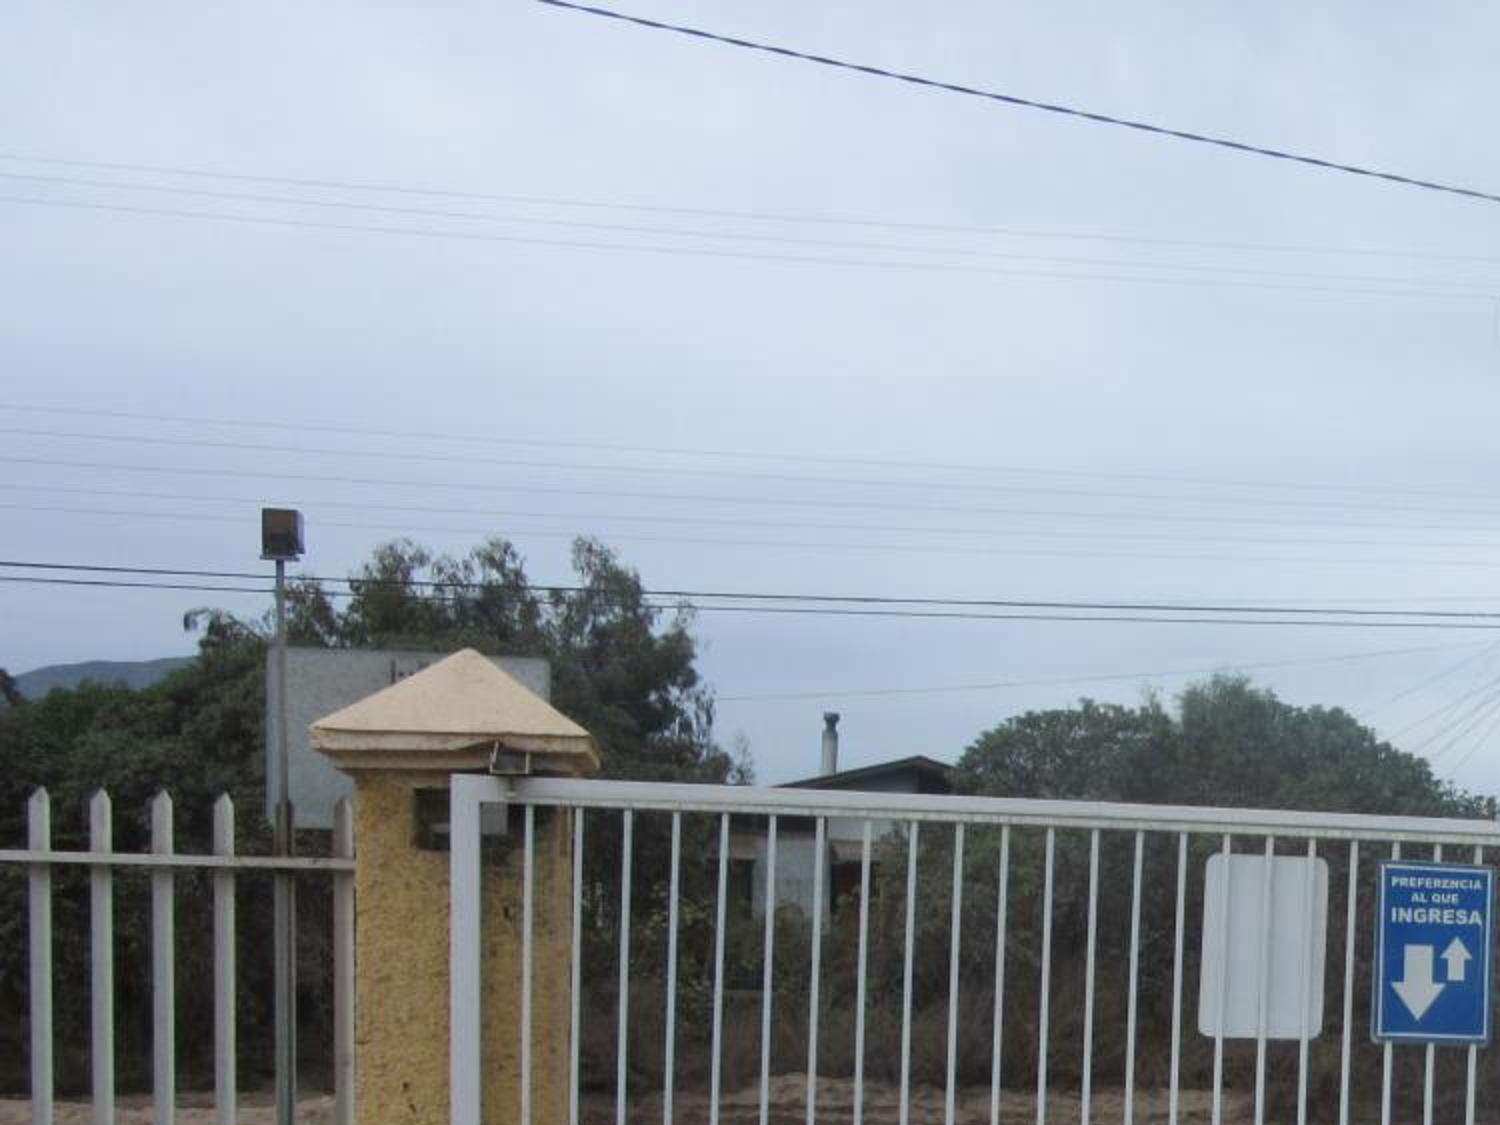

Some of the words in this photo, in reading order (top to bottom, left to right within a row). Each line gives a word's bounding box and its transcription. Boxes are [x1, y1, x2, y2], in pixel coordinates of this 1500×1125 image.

[1391, 875, 1483, 891] PREFERENCIA
[1411, 892, 1428, 904] AL
[1431, 893, 1460, 905] QUE
[1391, 906, 1483, 926] INGRESA
